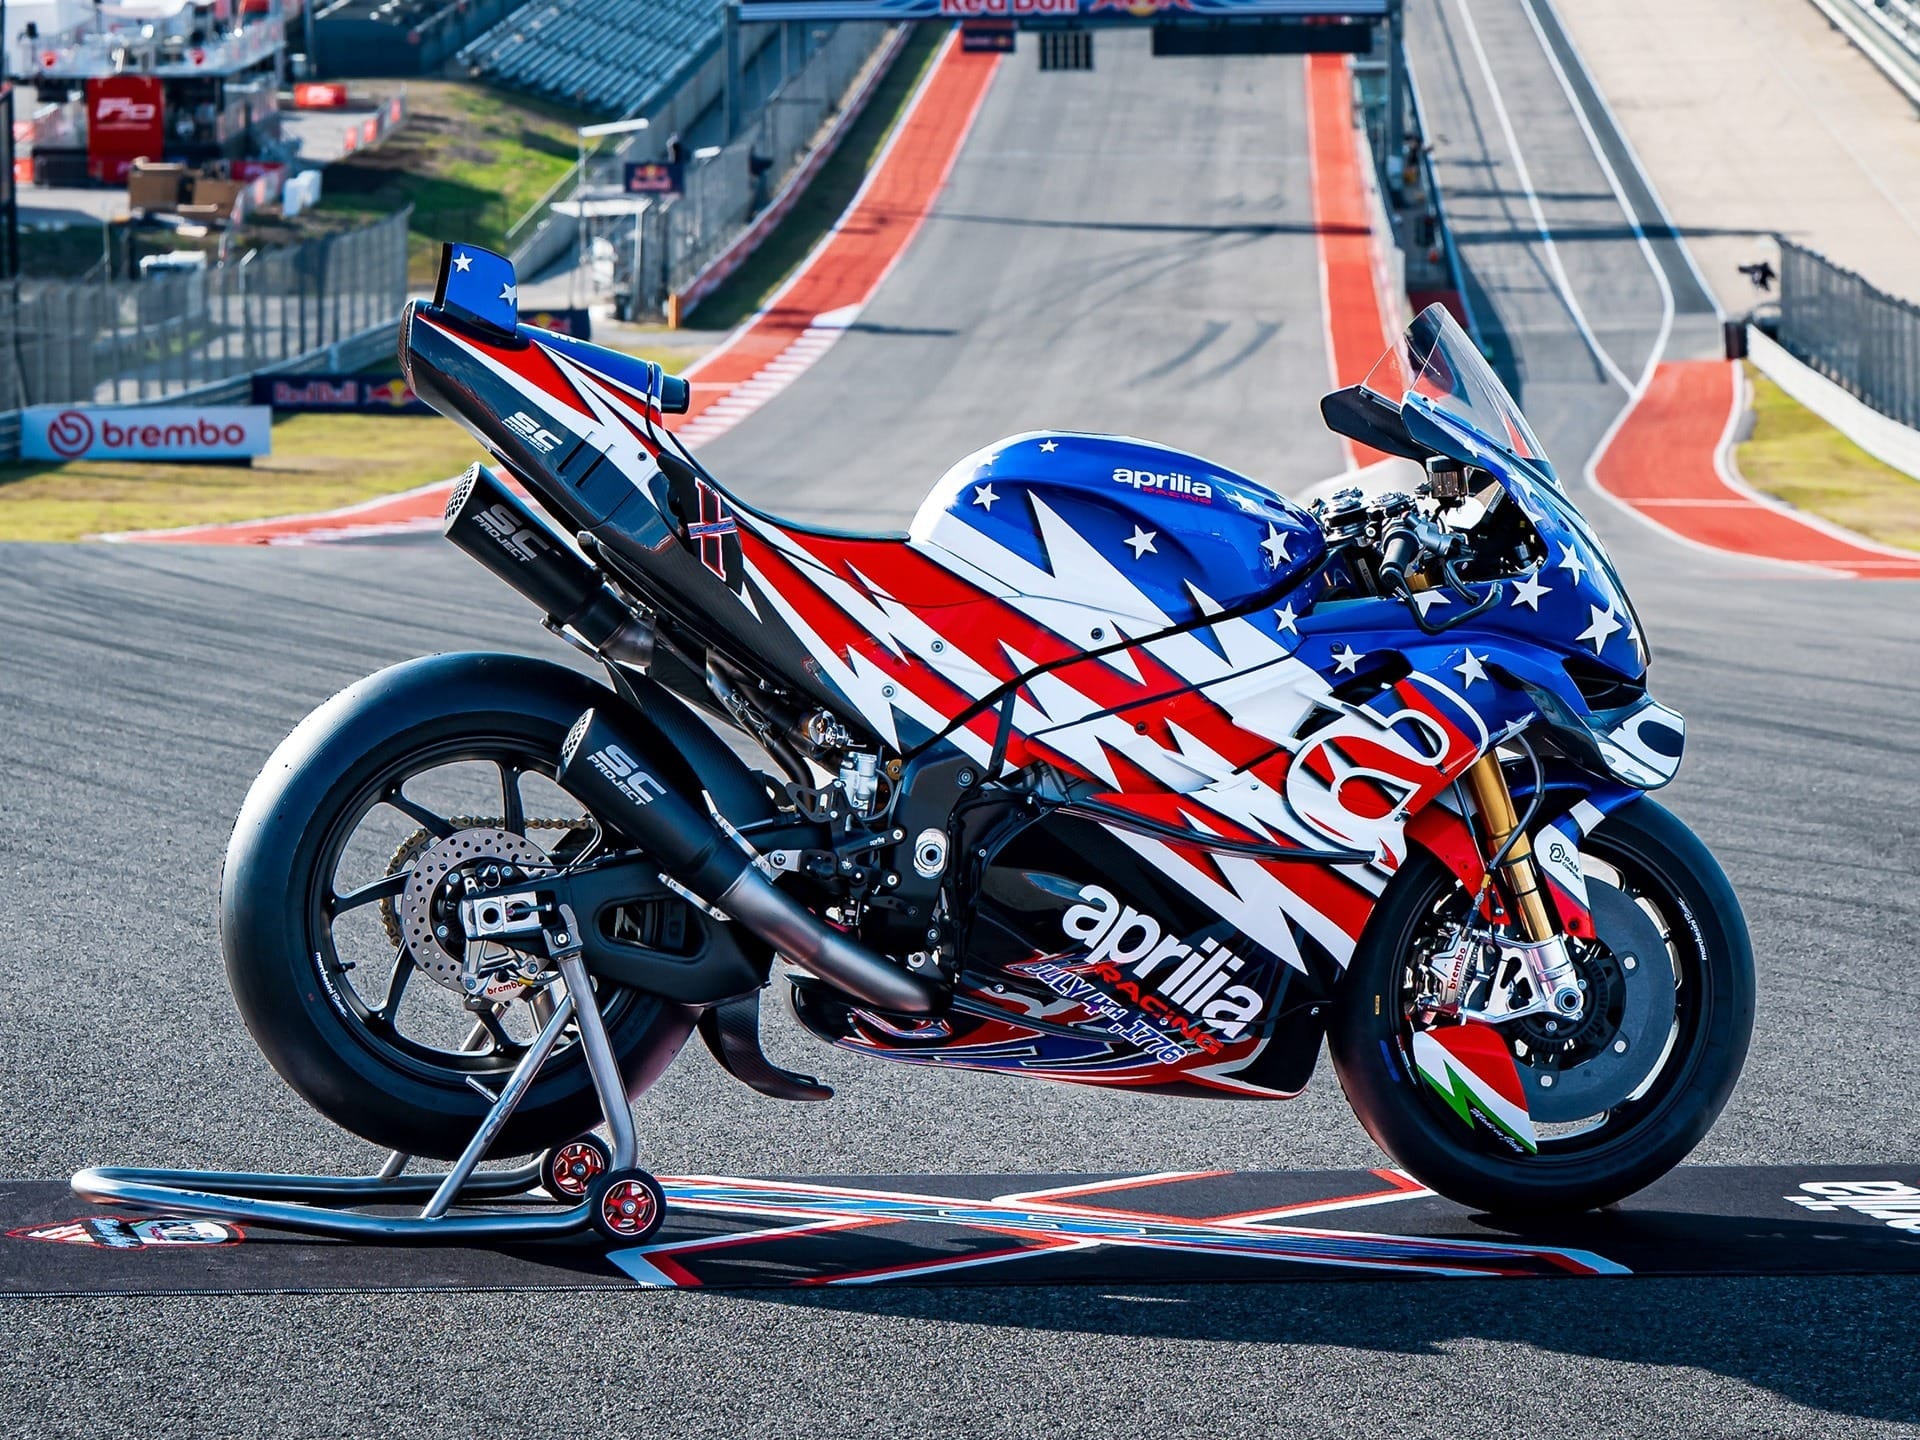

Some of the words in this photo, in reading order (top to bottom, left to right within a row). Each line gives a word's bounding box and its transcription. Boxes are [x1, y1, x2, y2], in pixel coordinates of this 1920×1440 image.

[102, 415, 244, 447] brembo
[508, 411, 563, 450] SC
[1112, 468, 1212, 499] aprilia
[471, 514, 531, 562] PROJECT
[480, 503, 550, 559] SC
[586, 754, 647, 806] PROJECT
[594, 744, 667, 803] SC
[1062, 884, 1264, 1039] aprilia
[1448, 947, 1466, 990] brembo
[1023, 963, 1096, 999] JULY
[1120, 1018, 1188, 1065] 1776
